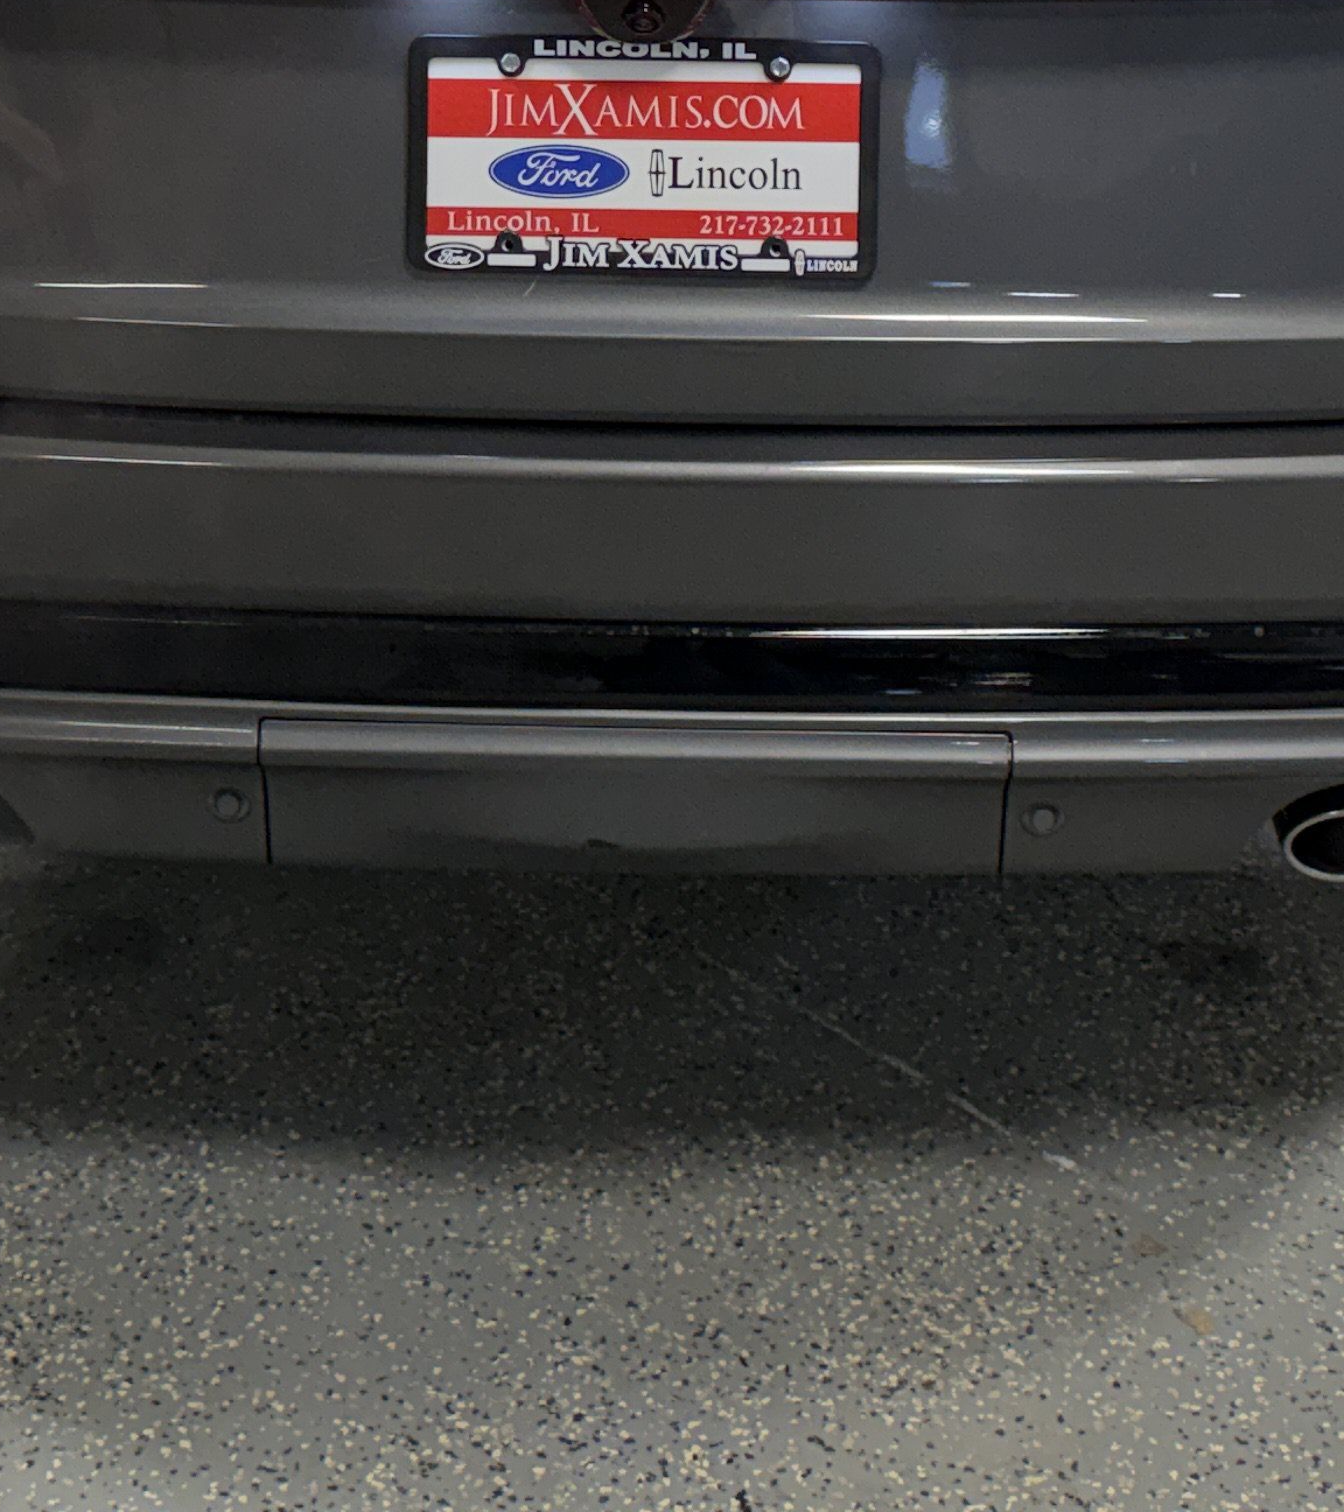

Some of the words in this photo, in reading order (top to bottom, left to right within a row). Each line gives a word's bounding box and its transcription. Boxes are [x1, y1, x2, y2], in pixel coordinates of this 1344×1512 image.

[533, 38, 710, 61] LINCOLN,
[721, 41, 757, 61] IL
[486, 83, 806, 137] JIMXAMIS.COM
[517, 150, 600, 189] Ford
[668, 155, 803, 191] Lincoln
[571, 212, 601, 234] IL
[699, 214, 844, 238] 217-732-2111
[543, 235, 611, 272] JIM
[617, 239, 741, 272] XAMIS
[806, 259, 859, 273] LINCOLN
